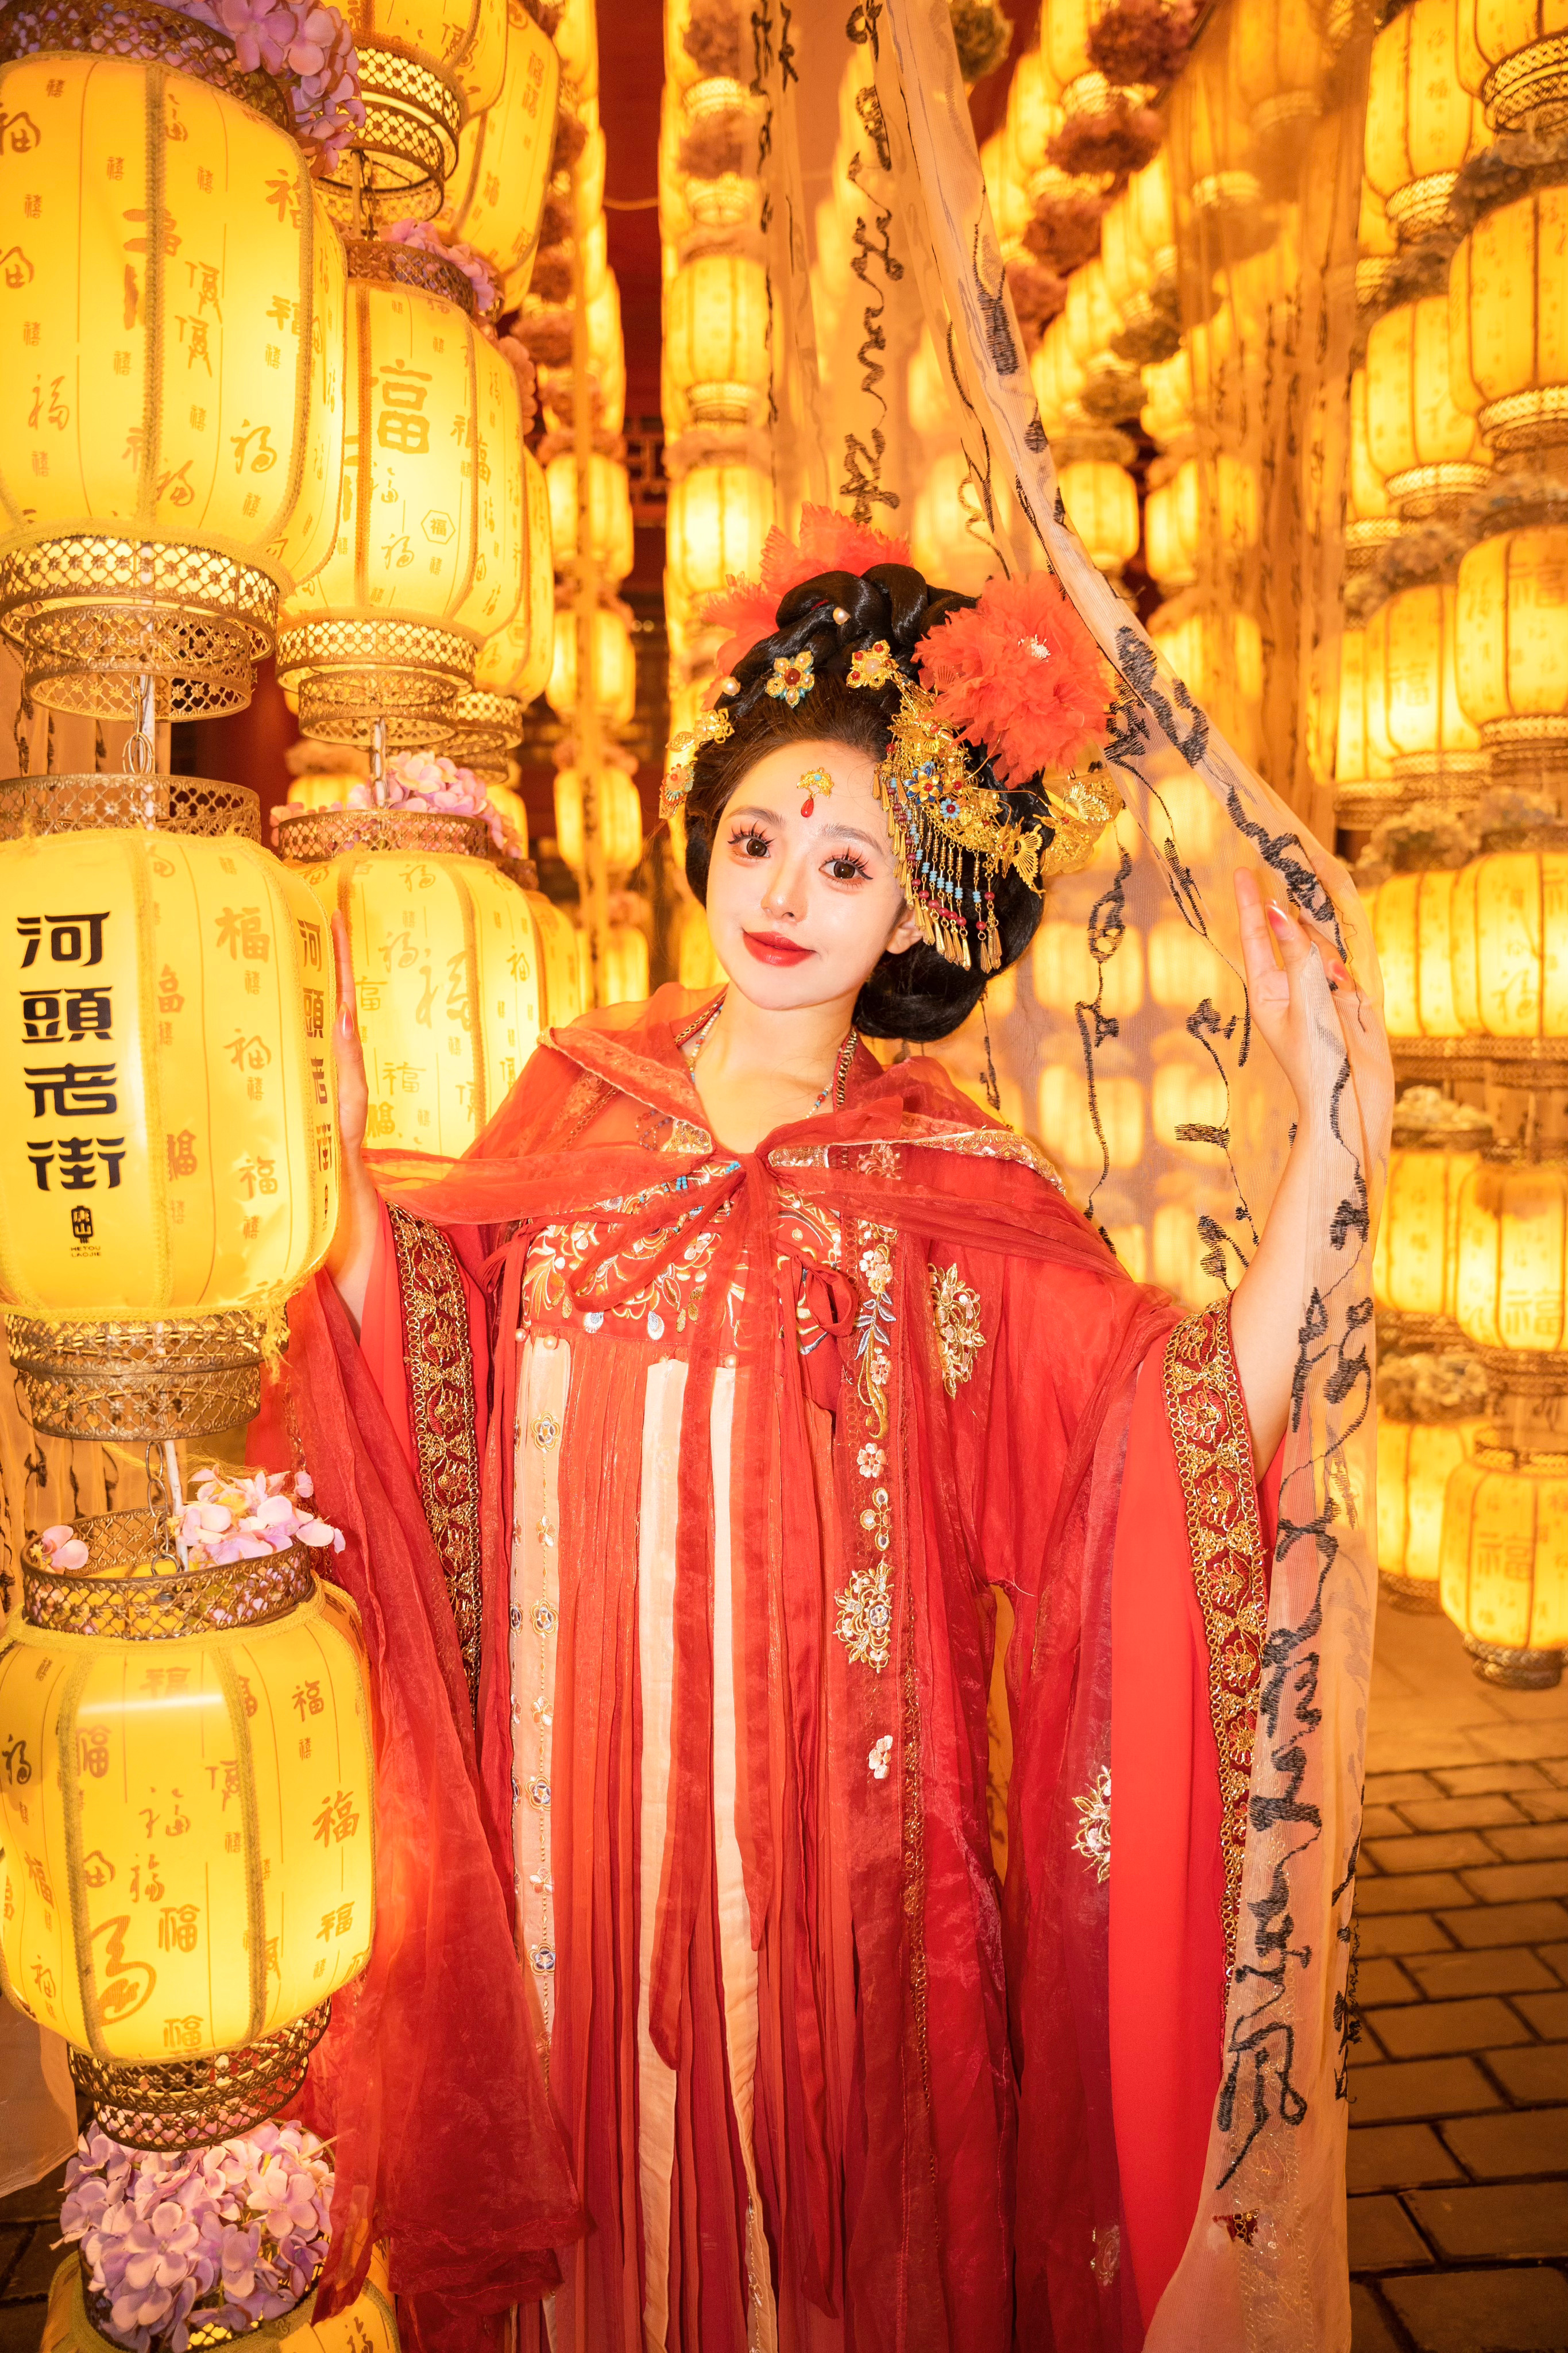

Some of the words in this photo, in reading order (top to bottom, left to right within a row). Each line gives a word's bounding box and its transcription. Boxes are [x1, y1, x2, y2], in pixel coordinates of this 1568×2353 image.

[430, 518, 447, 537] 福
[214, 907, 271, 963] 福
[378, 931, 418, 974] 福
[17, 911, 126, 1192] 河頭老街
[223, 1028, 271, 1073] 福
[297, 918, 333, 1172] 河頭老街
[382, 1061, 427, 1097] 福
[238, 1155, 278, 1201] 福
[291, 1680, 324, 1722] 福
[311, 1789, 360, 1848] 福
[158, 1903, 201, 1953] 福
[316, 1901, 356, 1943] 福
[163, 2014, 204, 2049] 福
